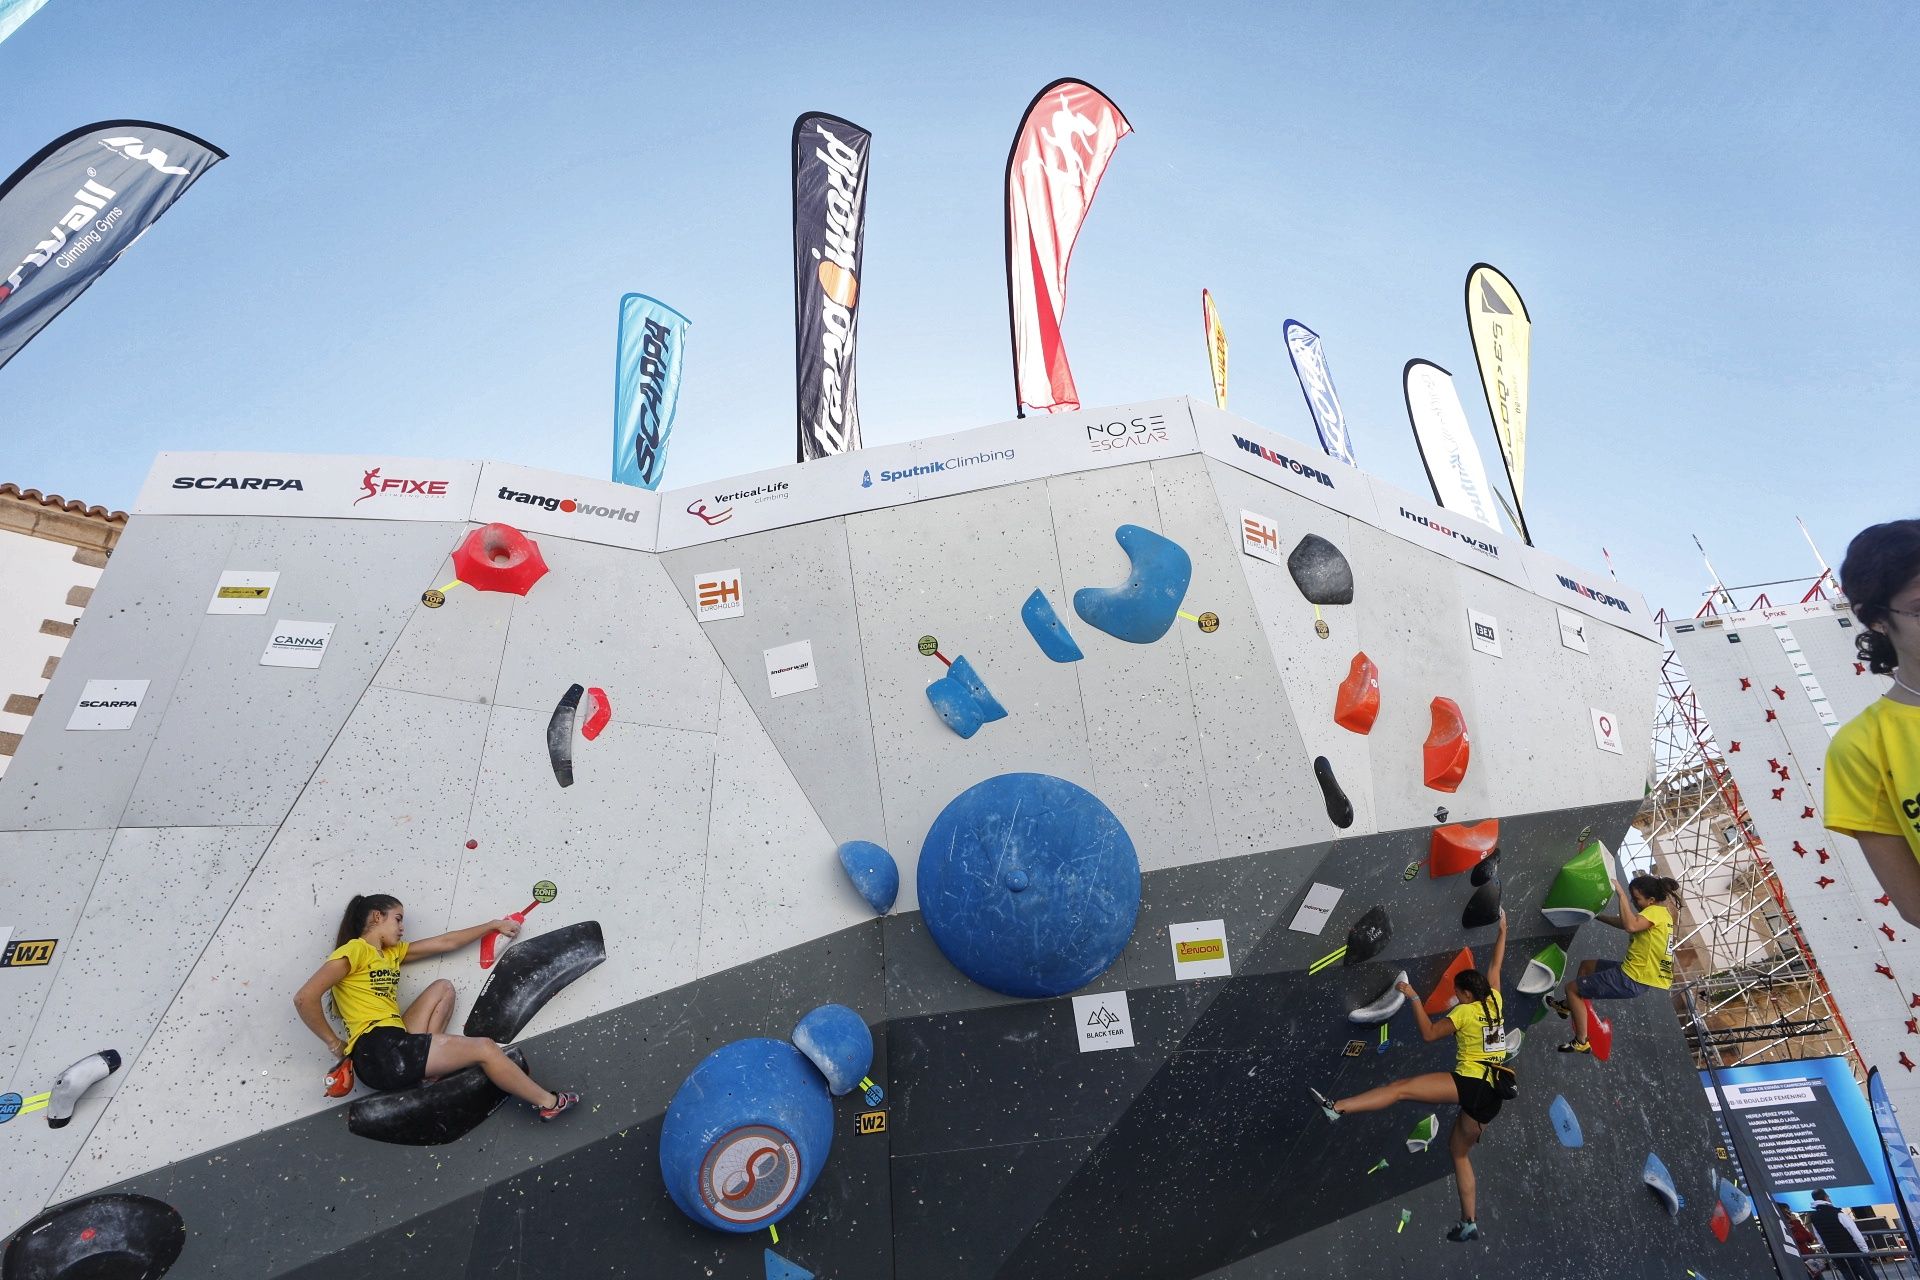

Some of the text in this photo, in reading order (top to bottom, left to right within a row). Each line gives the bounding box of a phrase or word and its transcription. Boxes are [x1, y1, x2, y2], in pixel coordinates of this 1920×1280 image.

[56, 206, 123, 269] Climbing Gyms
[634, 316, 671, 485] SCARPA
[1087, 415, 1166, 440] NOSE
[1090, 431, 1169, 452] ESCALAR
[1232, 434, 1335, 490] WALLTOPIA
[172, 476, 304, 492] SCARPA
[381, 479, 449, 494] FIXE
[714, 481, 789, 503] Vertical-Life
[754, 492, 789, 504] climbing
[1399, 506, 1499, 556] Indoorwall
[425, 594, 442, 604] TOP
[1555, 573, 1632, 614] WALLTOPIA
[1200, 619, 1217, 627] TOP
[275, 635, 325, 646] CANNA
[919, 642, 937, 650] ZONE
[79, 700, 138, 708] SCARPA
[533, 887, 556, 896] ZONE
[16, 945, 50, 962] W1
[1086, 1031, 1107, 1039] BLACK
[1743, 1096, 1774, 1104] BOULDER
[1773, 1093, 1807, 1101] FEMENINO
[863, 1115, 885, 1130] W2
